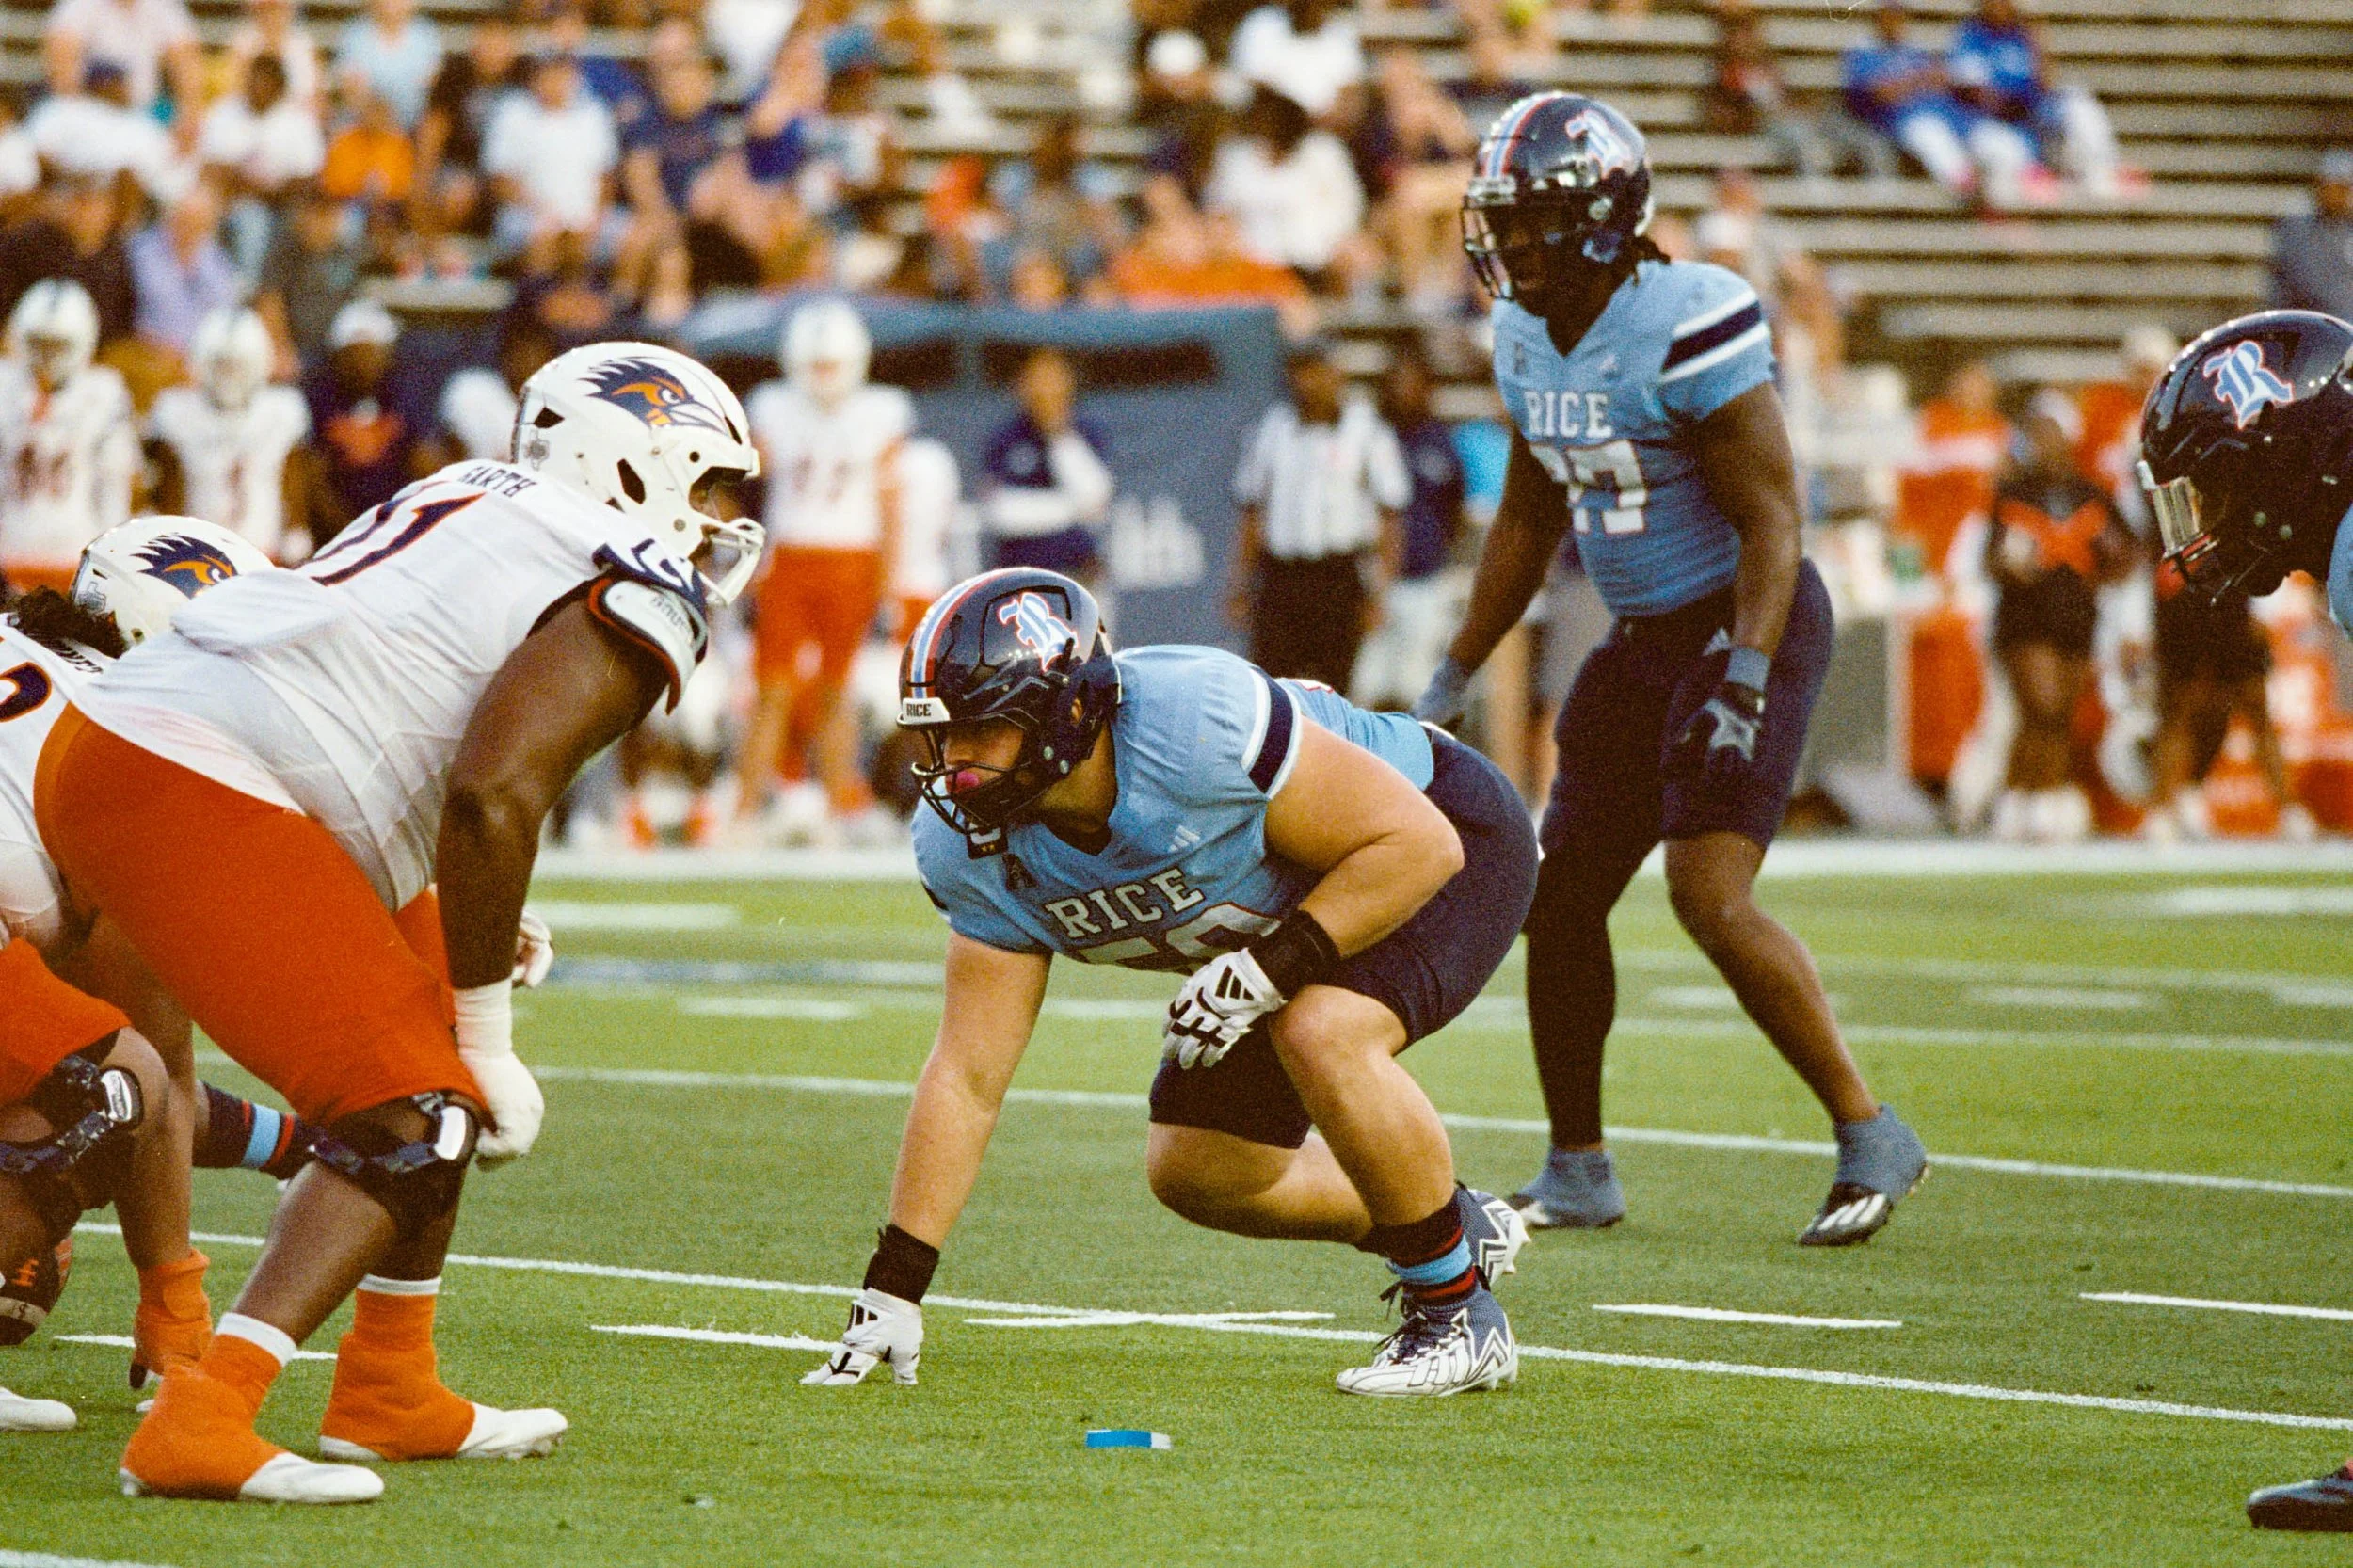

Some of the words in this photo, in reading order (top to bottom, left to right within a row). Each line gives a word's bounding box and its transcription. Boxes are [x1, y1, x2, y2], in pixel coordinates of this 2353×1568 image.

[1524, 391, 1613, 439] RICE
[2203, 340, 2295, 430] R
[999, 591, 1080, 672] R
[905, 702, 932, 717] RICE
[1044, 867, 1207, 939] RICE
